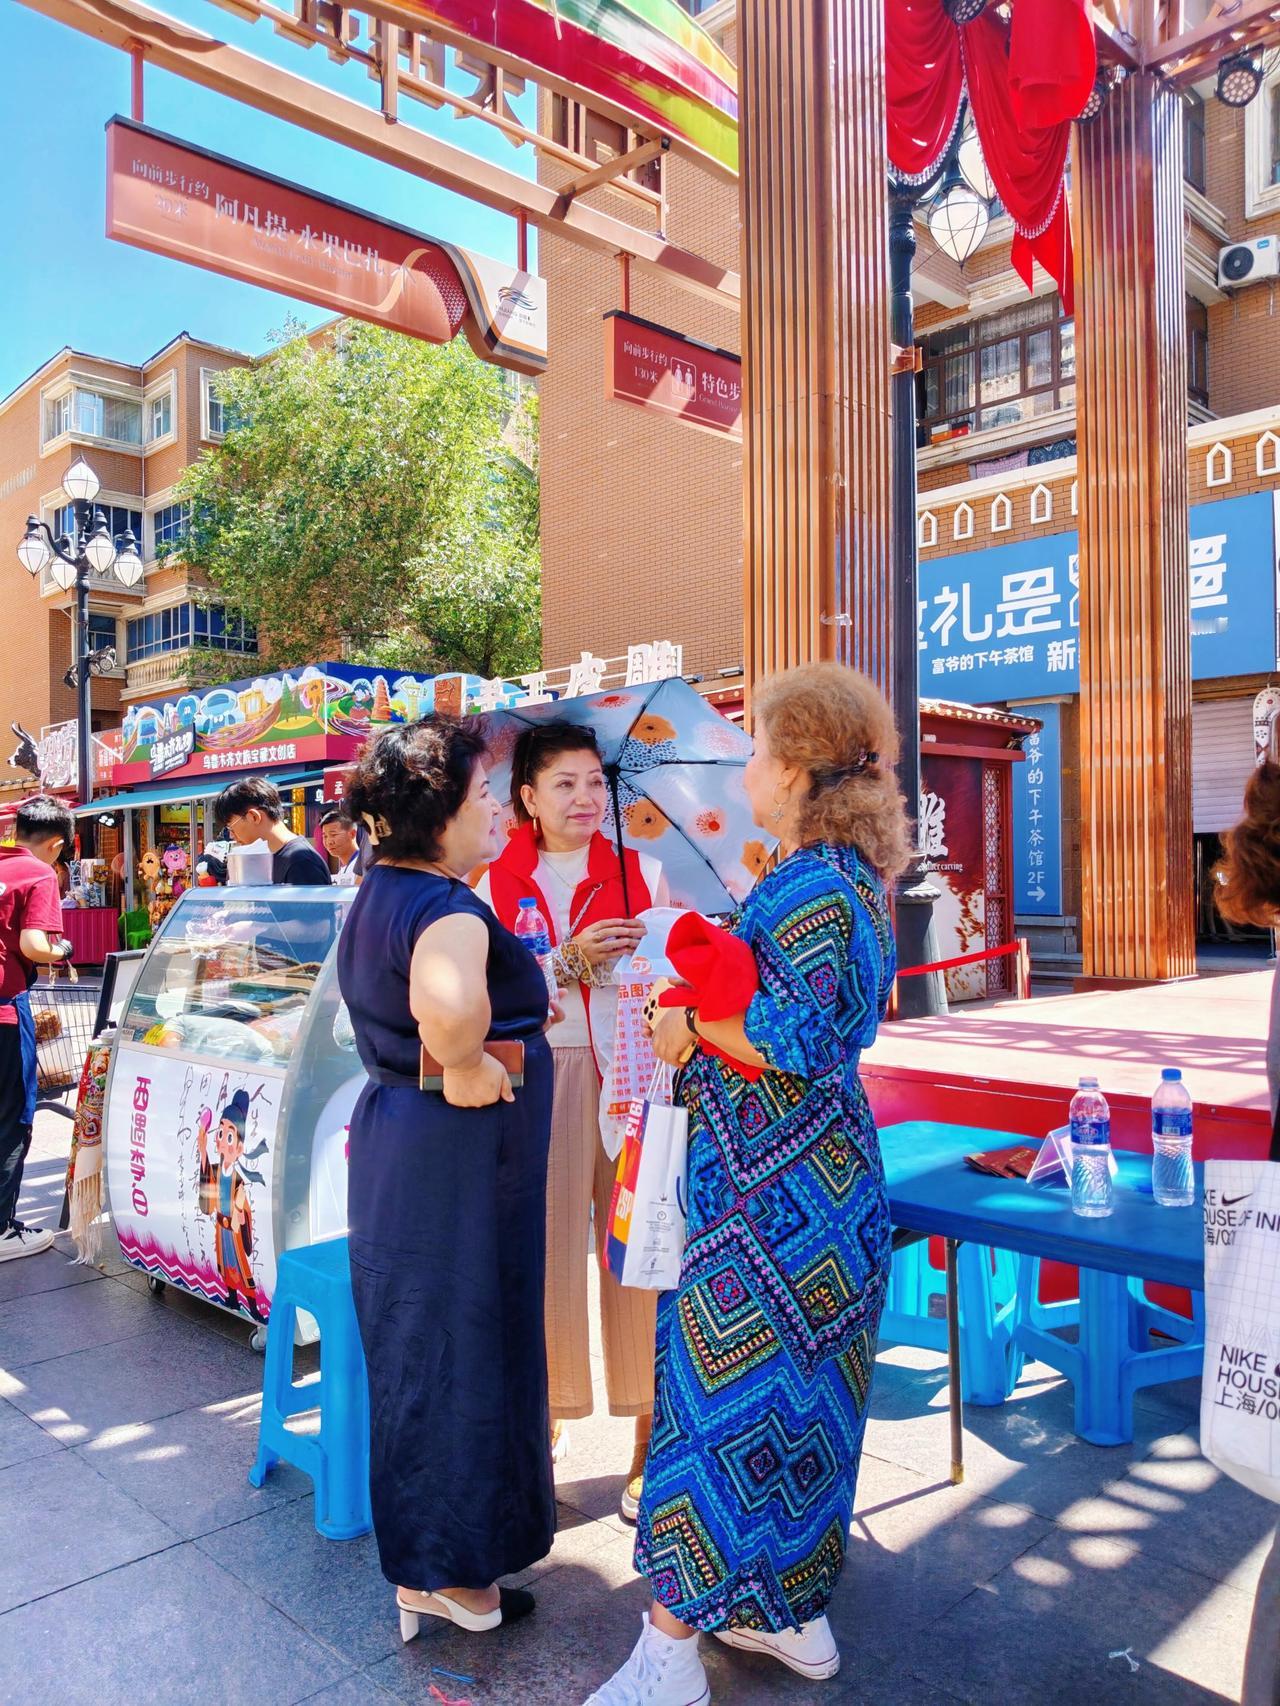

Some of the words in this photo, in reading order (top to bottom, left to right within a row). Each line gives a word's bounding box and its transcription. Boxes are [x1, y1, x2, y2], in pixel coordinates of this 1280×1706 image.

[132, 159, 209, 199] 向前步行约
[623, 340, 668, 367] 向前步行约
[634, 366, 658, 383] 130米
[932, 645, 1034, 675] 富爷的下午茶馆
[1028, 871, 1045, 884] 2F
[1220, 1344, 1267, 1373] NIKE
